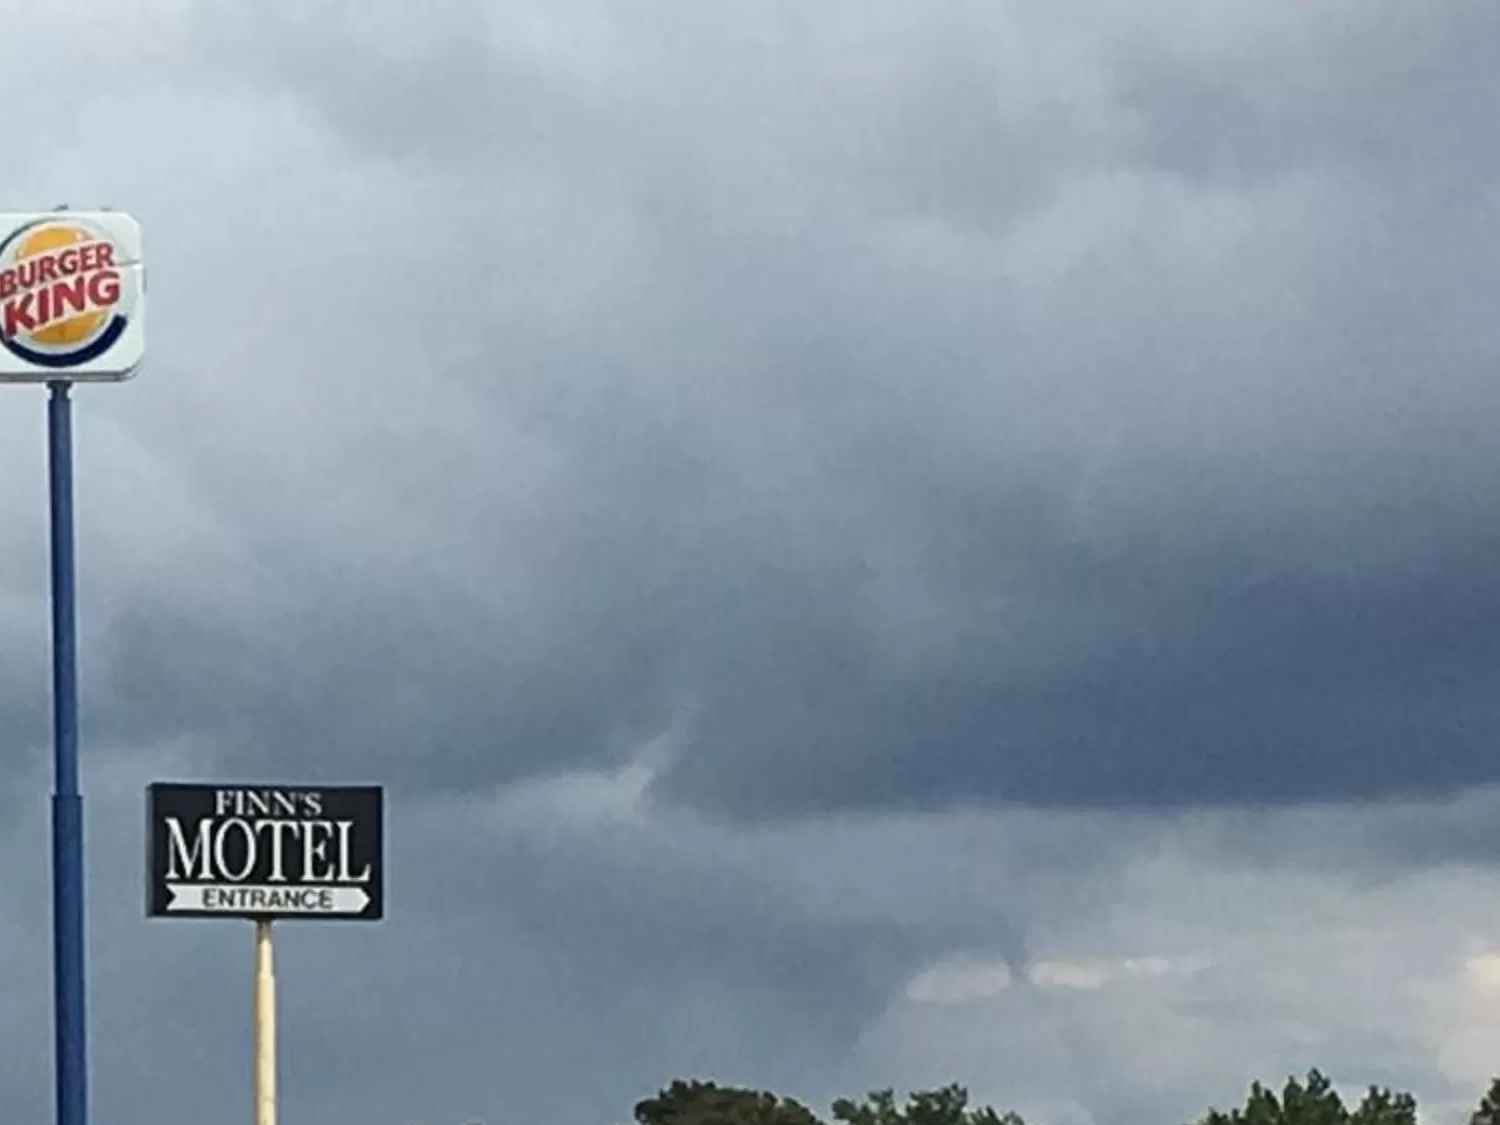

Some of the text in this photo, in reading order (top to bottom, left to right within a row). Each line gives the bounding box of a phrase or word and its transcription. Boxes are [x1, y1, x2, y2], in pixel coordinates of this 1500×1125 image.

[3, 271, 120, 339] KING
[215, 789, 323, 817] FINN'S
[164, 817, 371, 882] MOTEL
[202, 888, 334, 910] ENTRANCE
